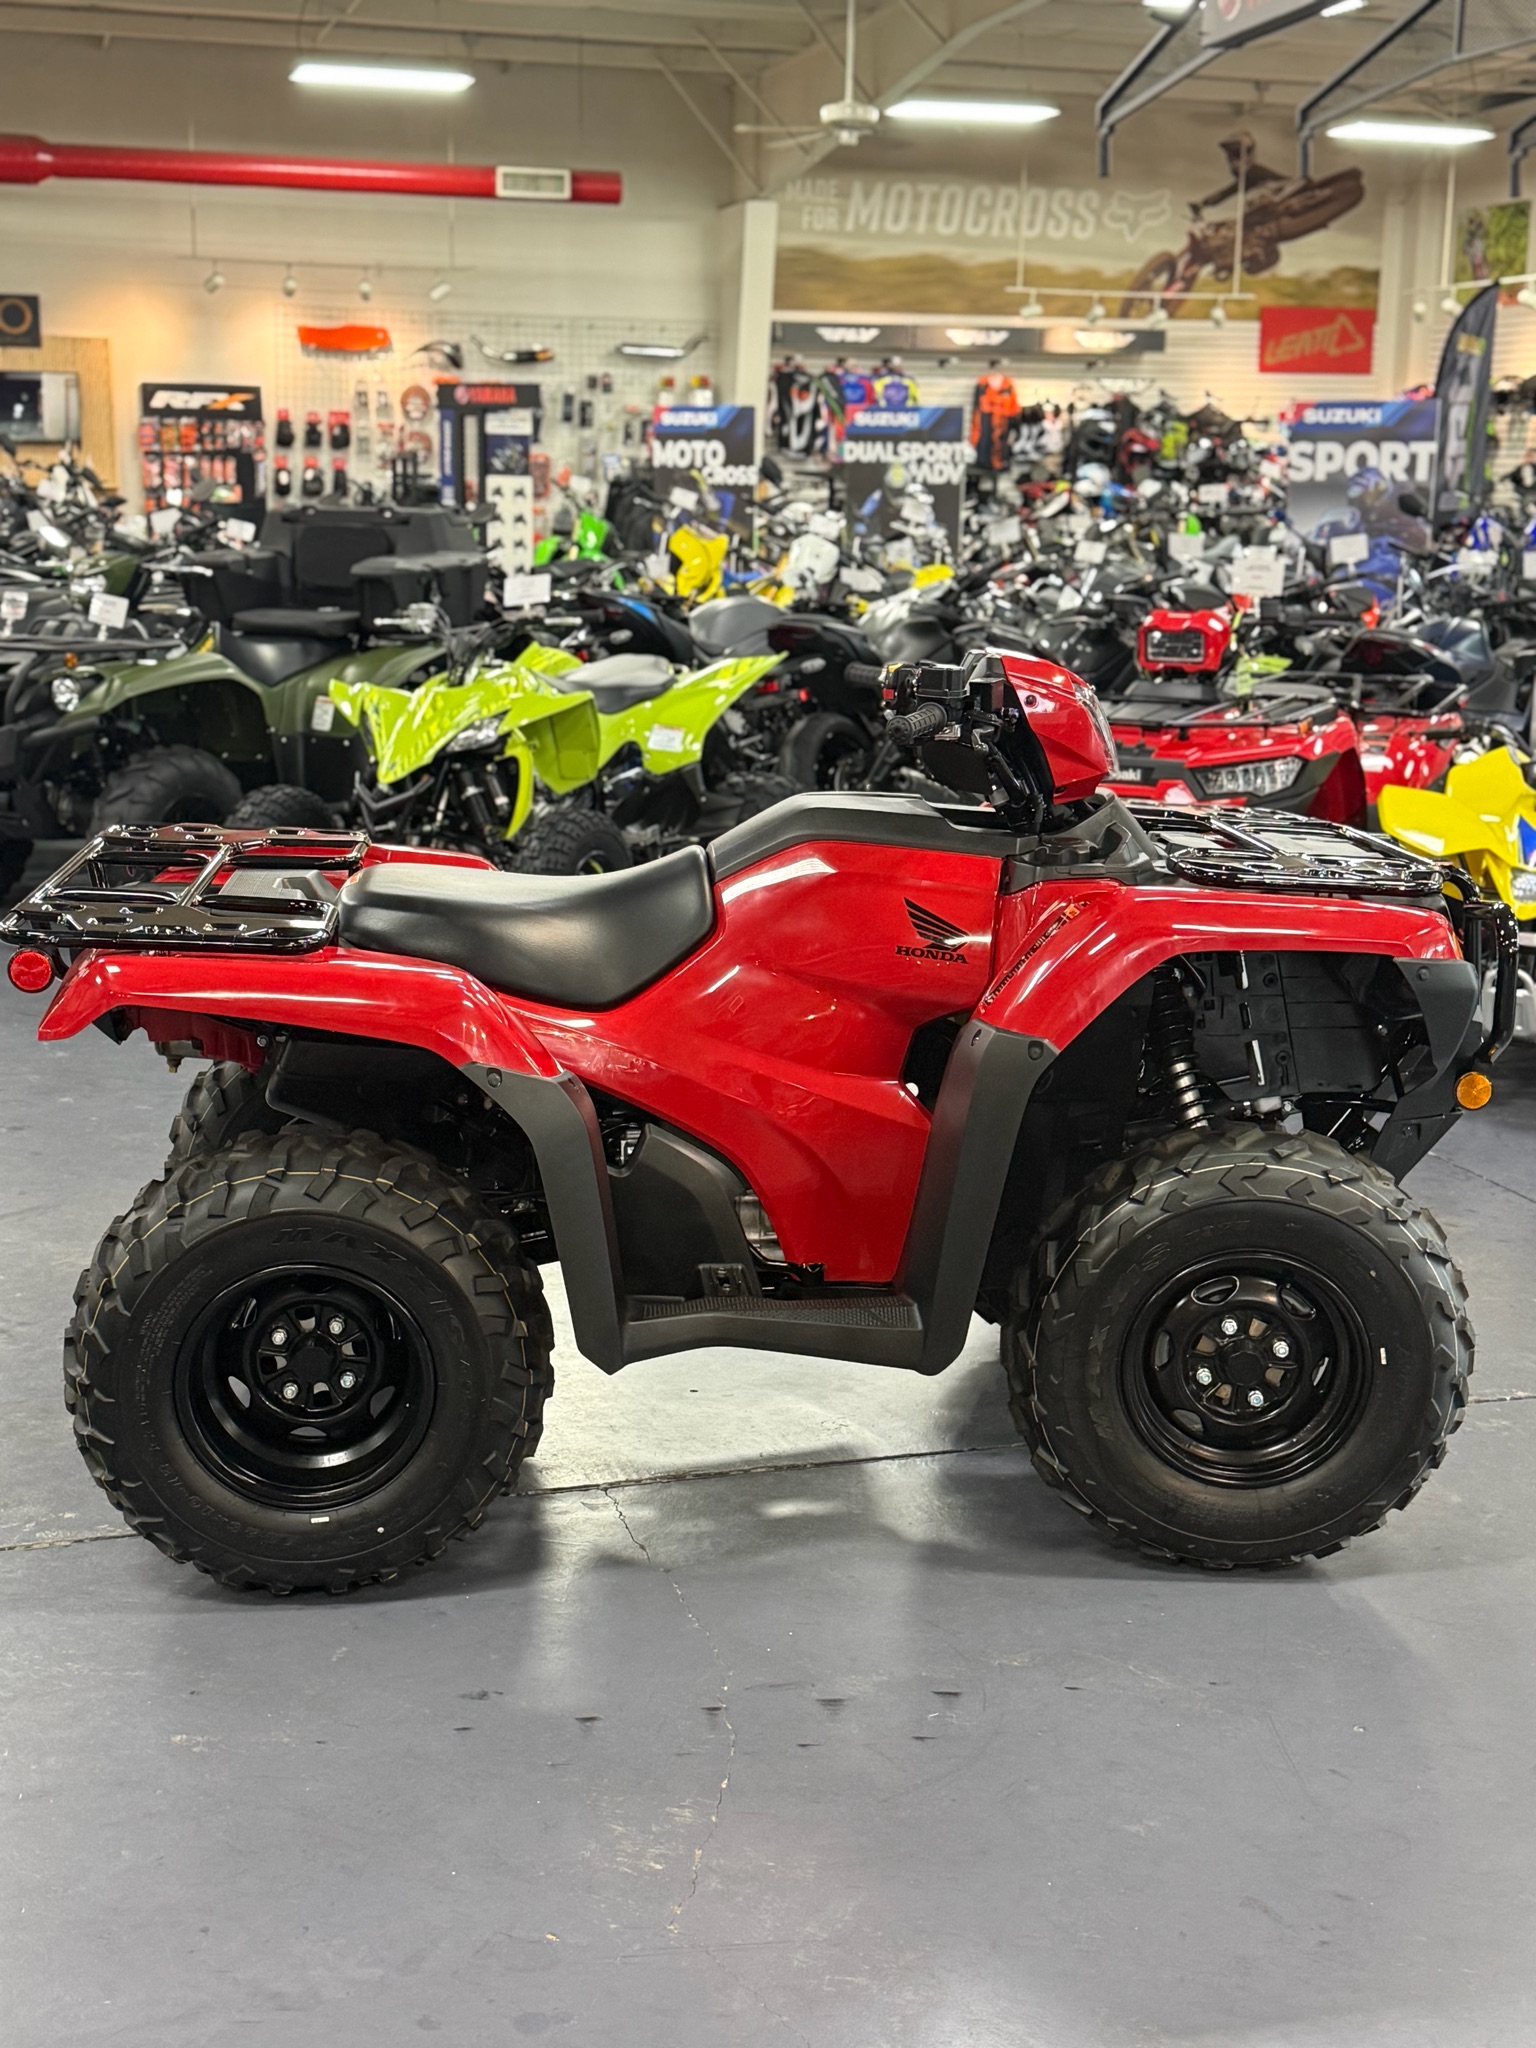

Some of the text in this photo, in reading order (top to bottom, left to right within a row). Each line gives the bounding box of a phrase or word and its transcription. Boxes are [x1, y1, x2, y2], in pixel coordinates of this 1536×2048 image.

[785, 178, 840, 202] MADE
[801, 181, 1099, 240] FOR MOTOCROSS
[660, 411, 717, 426] SUZUKI
[853, 411, 920, 427] SUZUKI
[1302, 407, 1382, 425] SUZUKI
[652, 439, 726, 468] MOTO
[1288, 441, 1438, 482] SPORT
[701, 465, 759, 486] CROSS
[916, 463, 967, 485] ADV
[895, 945, 969, 965] HONDA
